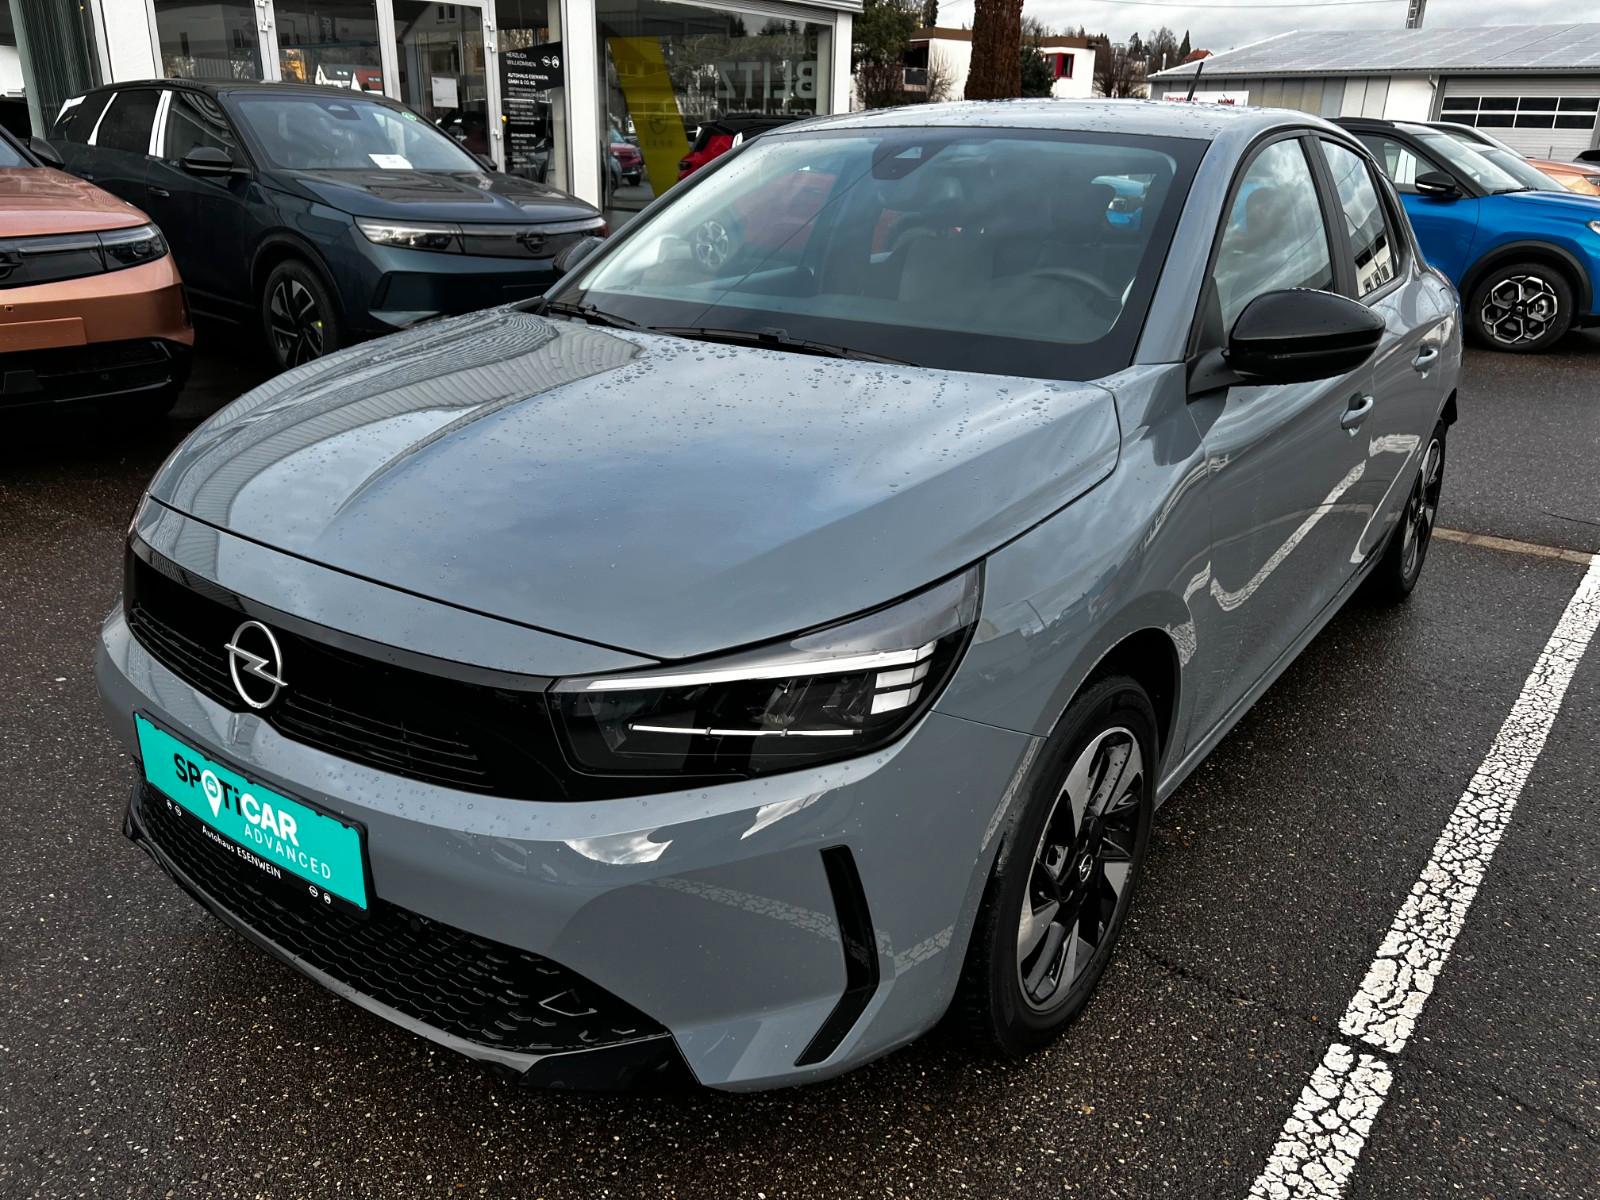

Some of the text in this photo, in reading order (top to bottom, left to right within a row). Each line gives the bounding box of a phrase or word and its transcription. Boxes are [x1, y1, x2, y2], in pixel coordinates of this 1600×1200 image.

[202, 825, 282, 880] Autohaus ESENWEIN
[244, 823, 332, 880] ADVANCED
